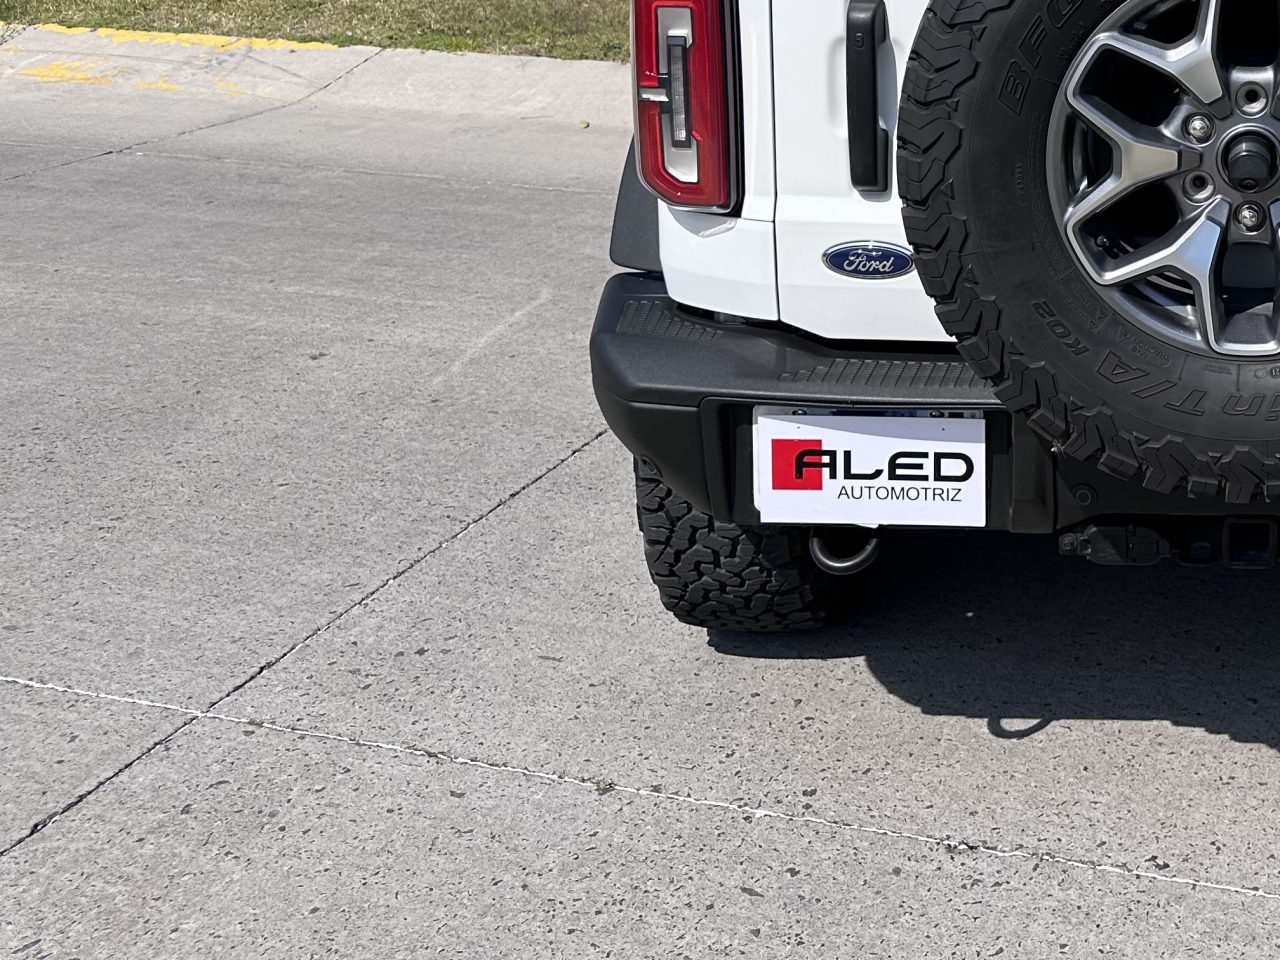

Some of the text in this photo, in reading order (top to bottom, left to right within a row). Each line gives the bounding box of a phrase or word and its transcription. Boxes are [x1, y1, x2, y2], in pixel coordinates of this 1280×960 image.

[843, 250, 894, 272] Ford
[1096, 351, 1208, 414] T/A
[795, 449, 974, 482] ALED
[837, 485, 962, 502] AUTOMOTRIZ
